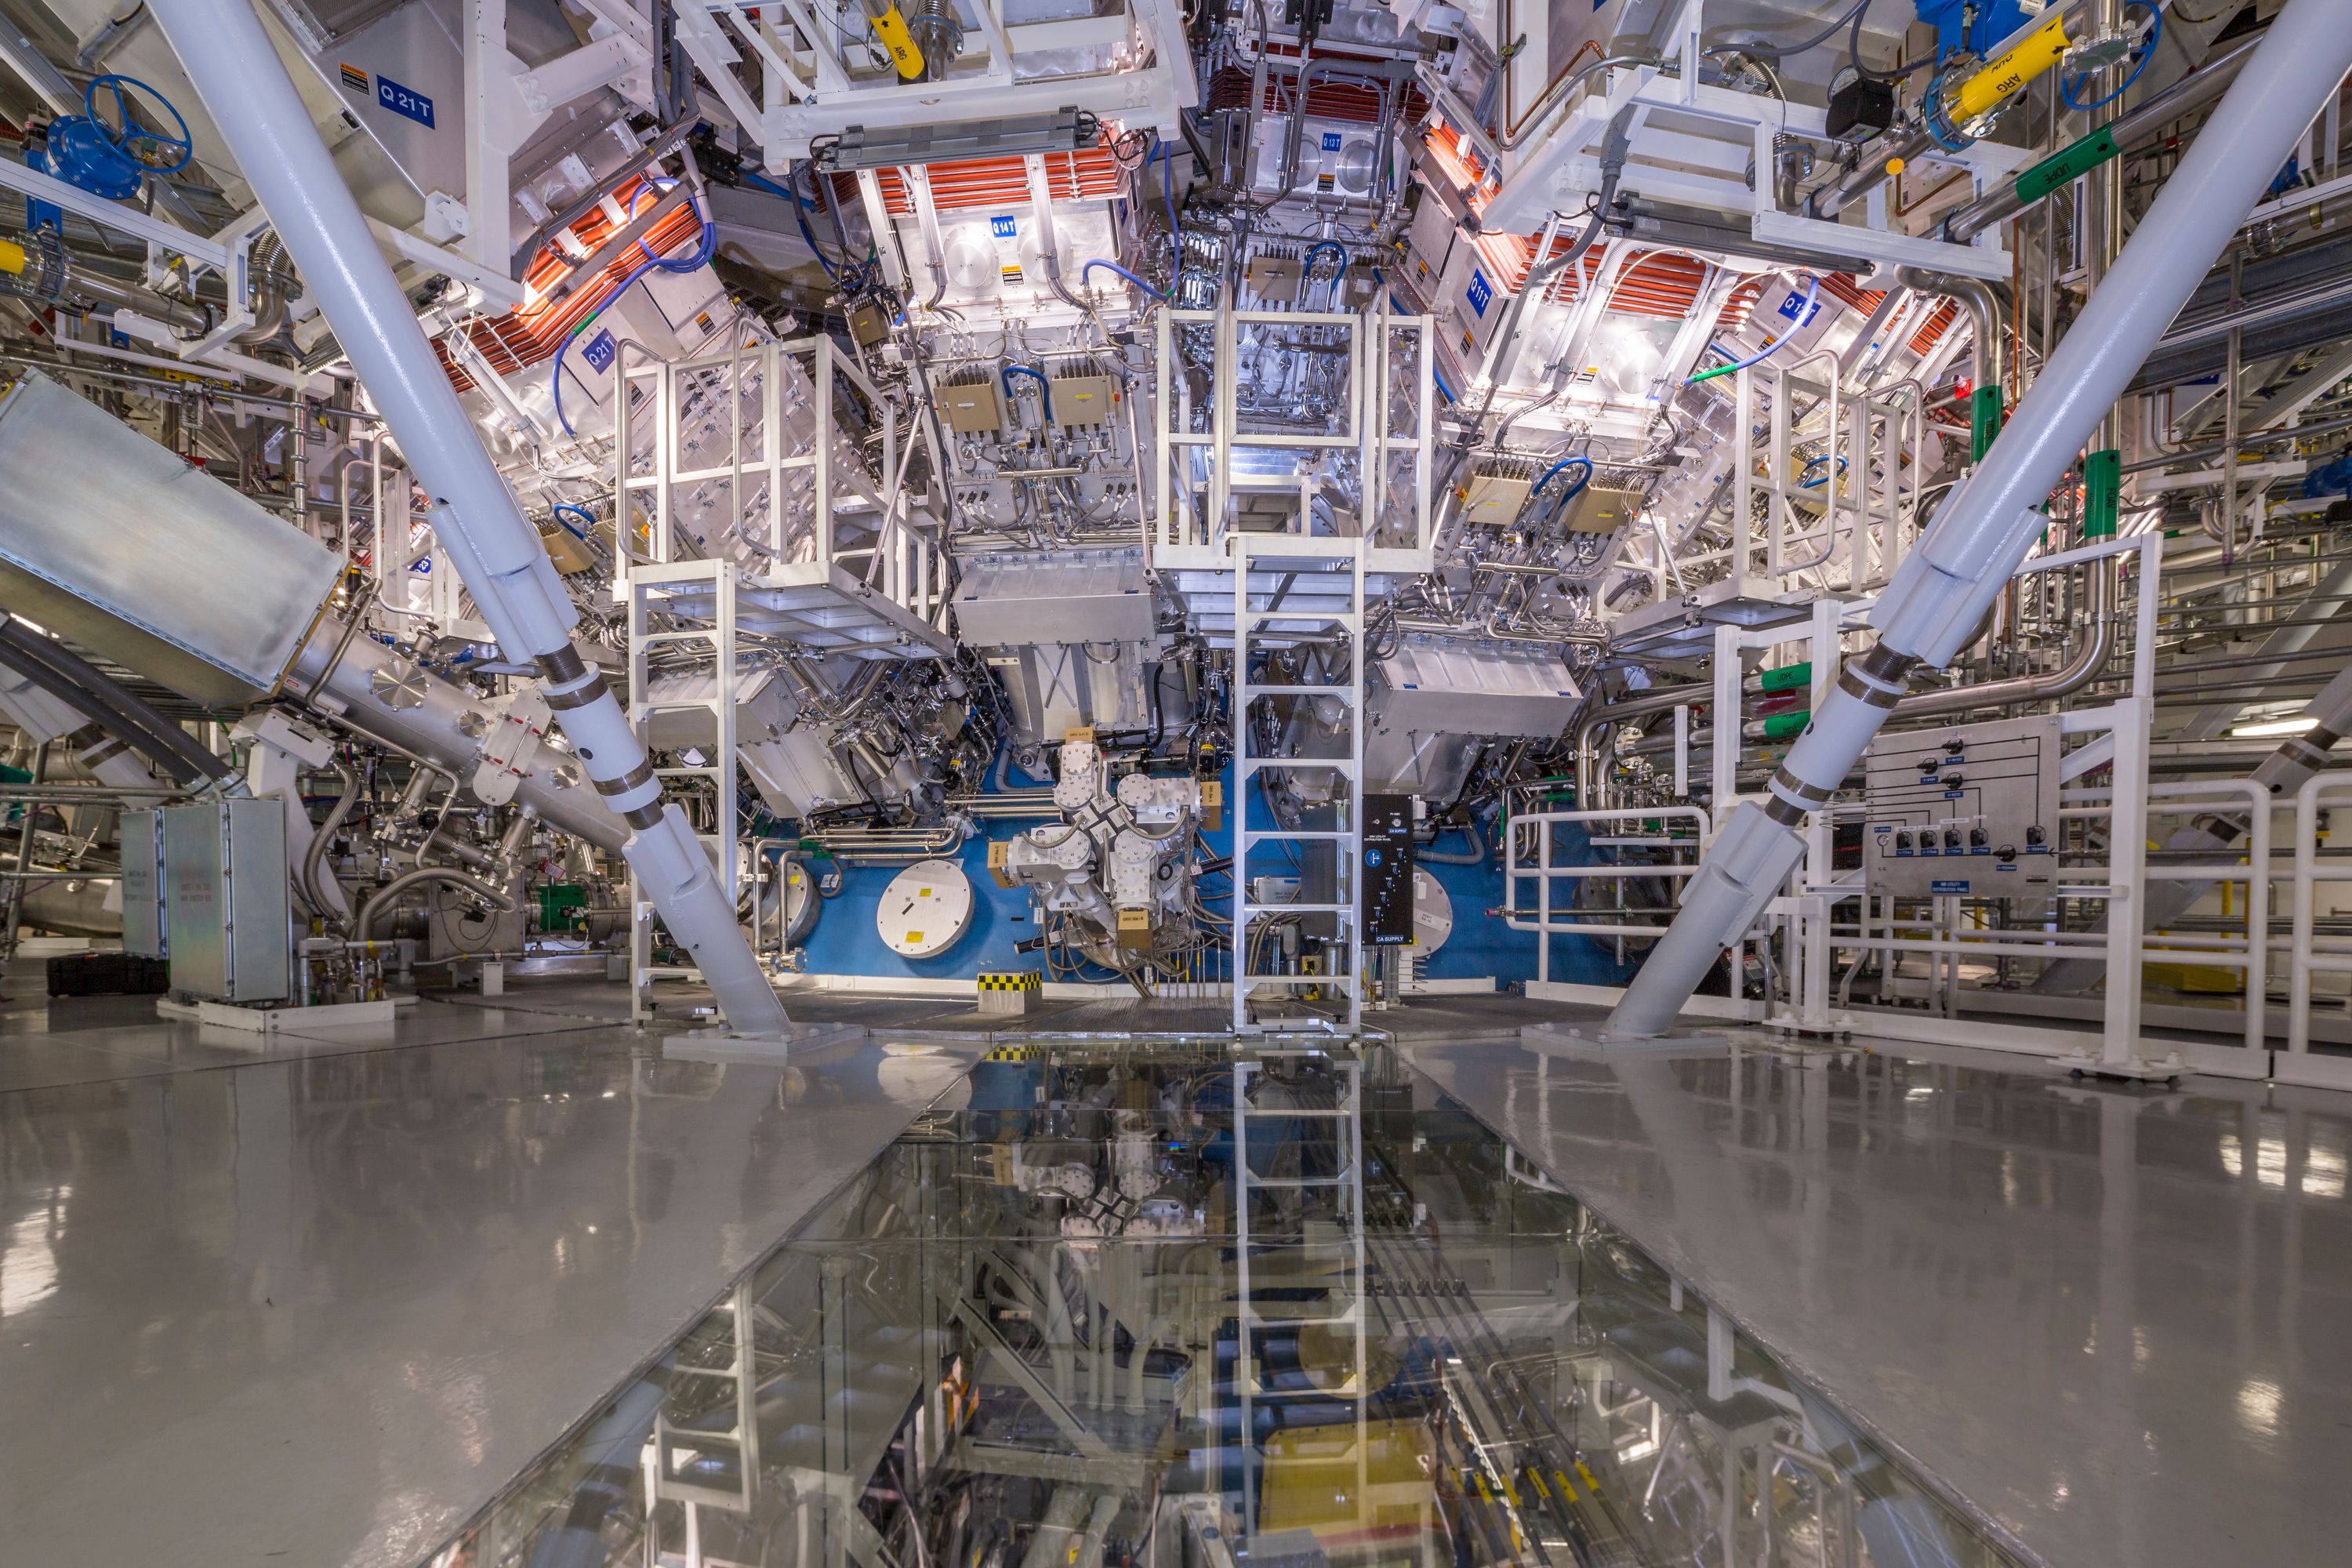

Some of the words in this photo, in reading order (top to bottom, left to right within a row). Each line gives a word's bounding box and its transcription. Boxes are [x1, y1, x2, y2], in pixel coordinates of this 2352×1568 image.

[894, 46, 907, 60] ARG
[1996, 73, 2021, 93] ARG
[380, 85, 394, 102] Q
[398, 93, 416, 111] 21
[419, 101, 430, 117] T
[1323, 137, 1328, 147] Q
[2043, 163, 2071, 185] UDPE
[993, 222, 1000, 234] Q
[1471, 277, 1478, 293] Q
[1785, 297, 1795, 310] Q
[588, 353, 601, 366] Q
[596, 343, 610, 359] 21
[604, 335, 615, 347] T
[1777, 671, 1794, 682] UDPE
